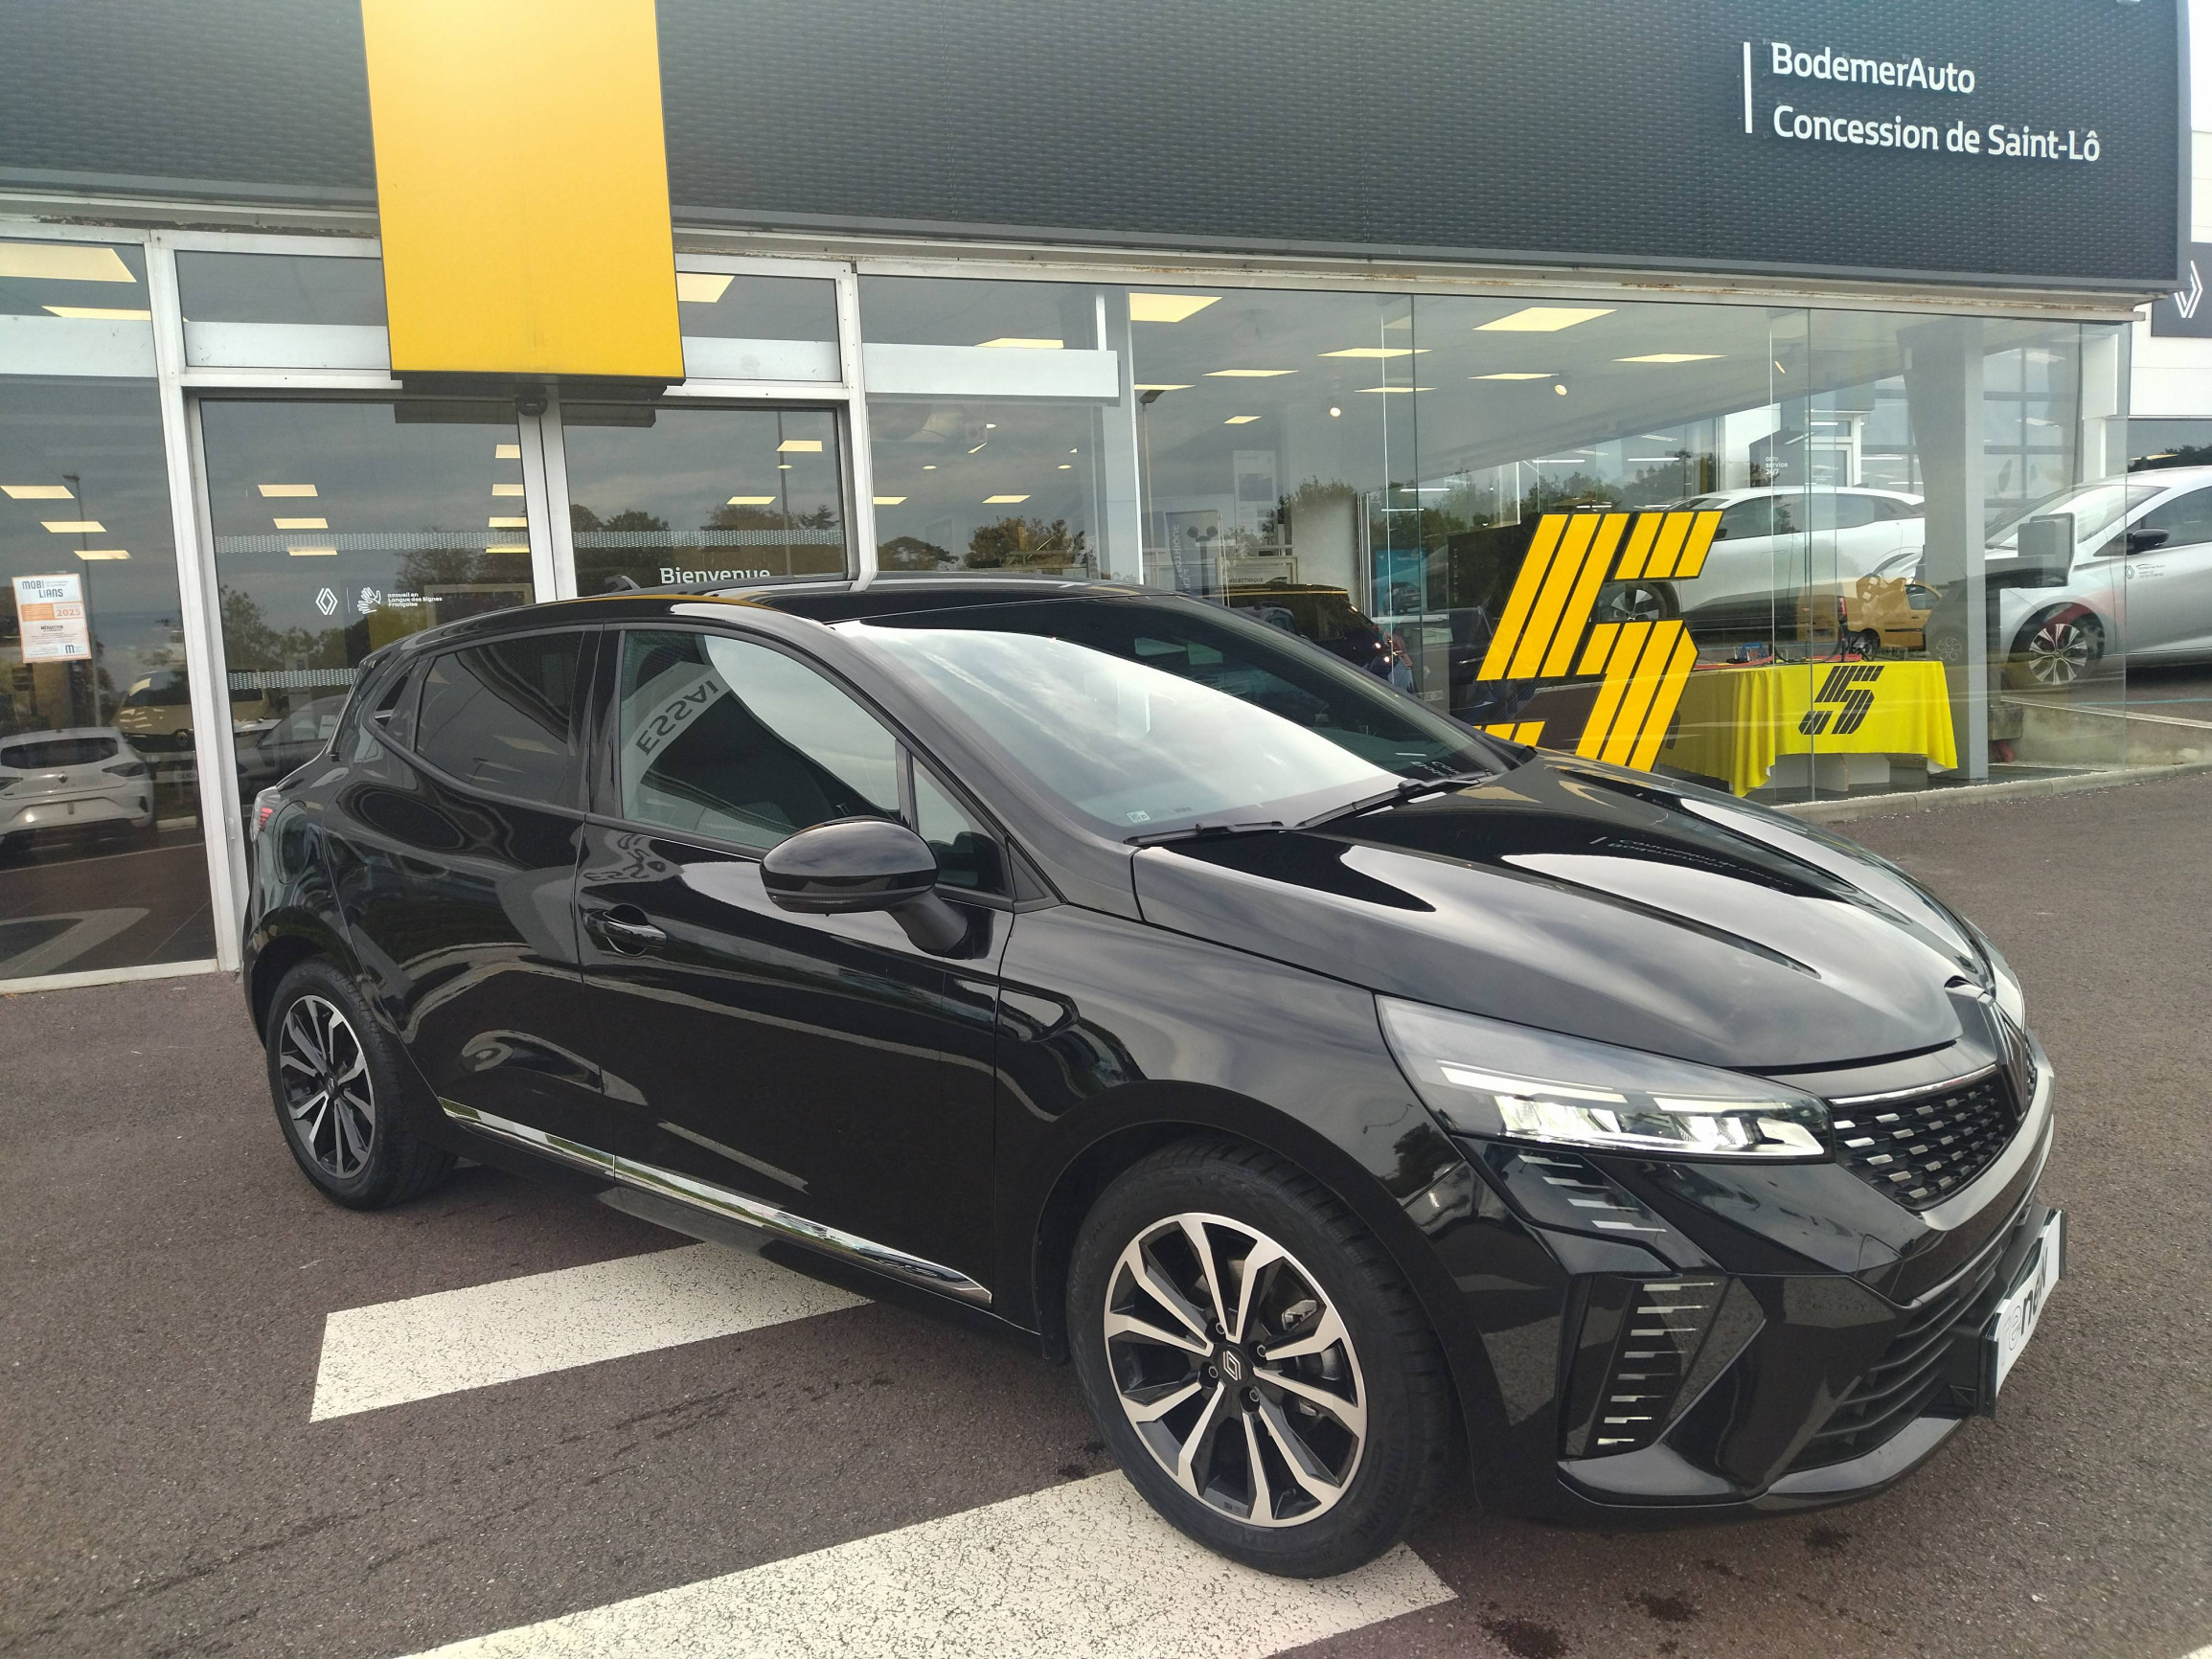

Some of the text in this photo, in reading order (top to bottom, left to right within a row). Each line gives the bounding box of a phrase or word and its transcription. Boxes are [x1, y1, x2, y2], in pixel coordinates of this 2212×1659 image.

[1770, 42, 1975, 94] BodemerAuto
[1773, 105, 2101, 162] Concession de Saint-Lô
[659, 567, 770, 584] Bienvenue
[22, 580, 45, 590] MOBI
[39, 588, 63, 599] LIANS
[57, 608, 80, 617] 2025
[2000, 1247, 2048, 1366] renew
